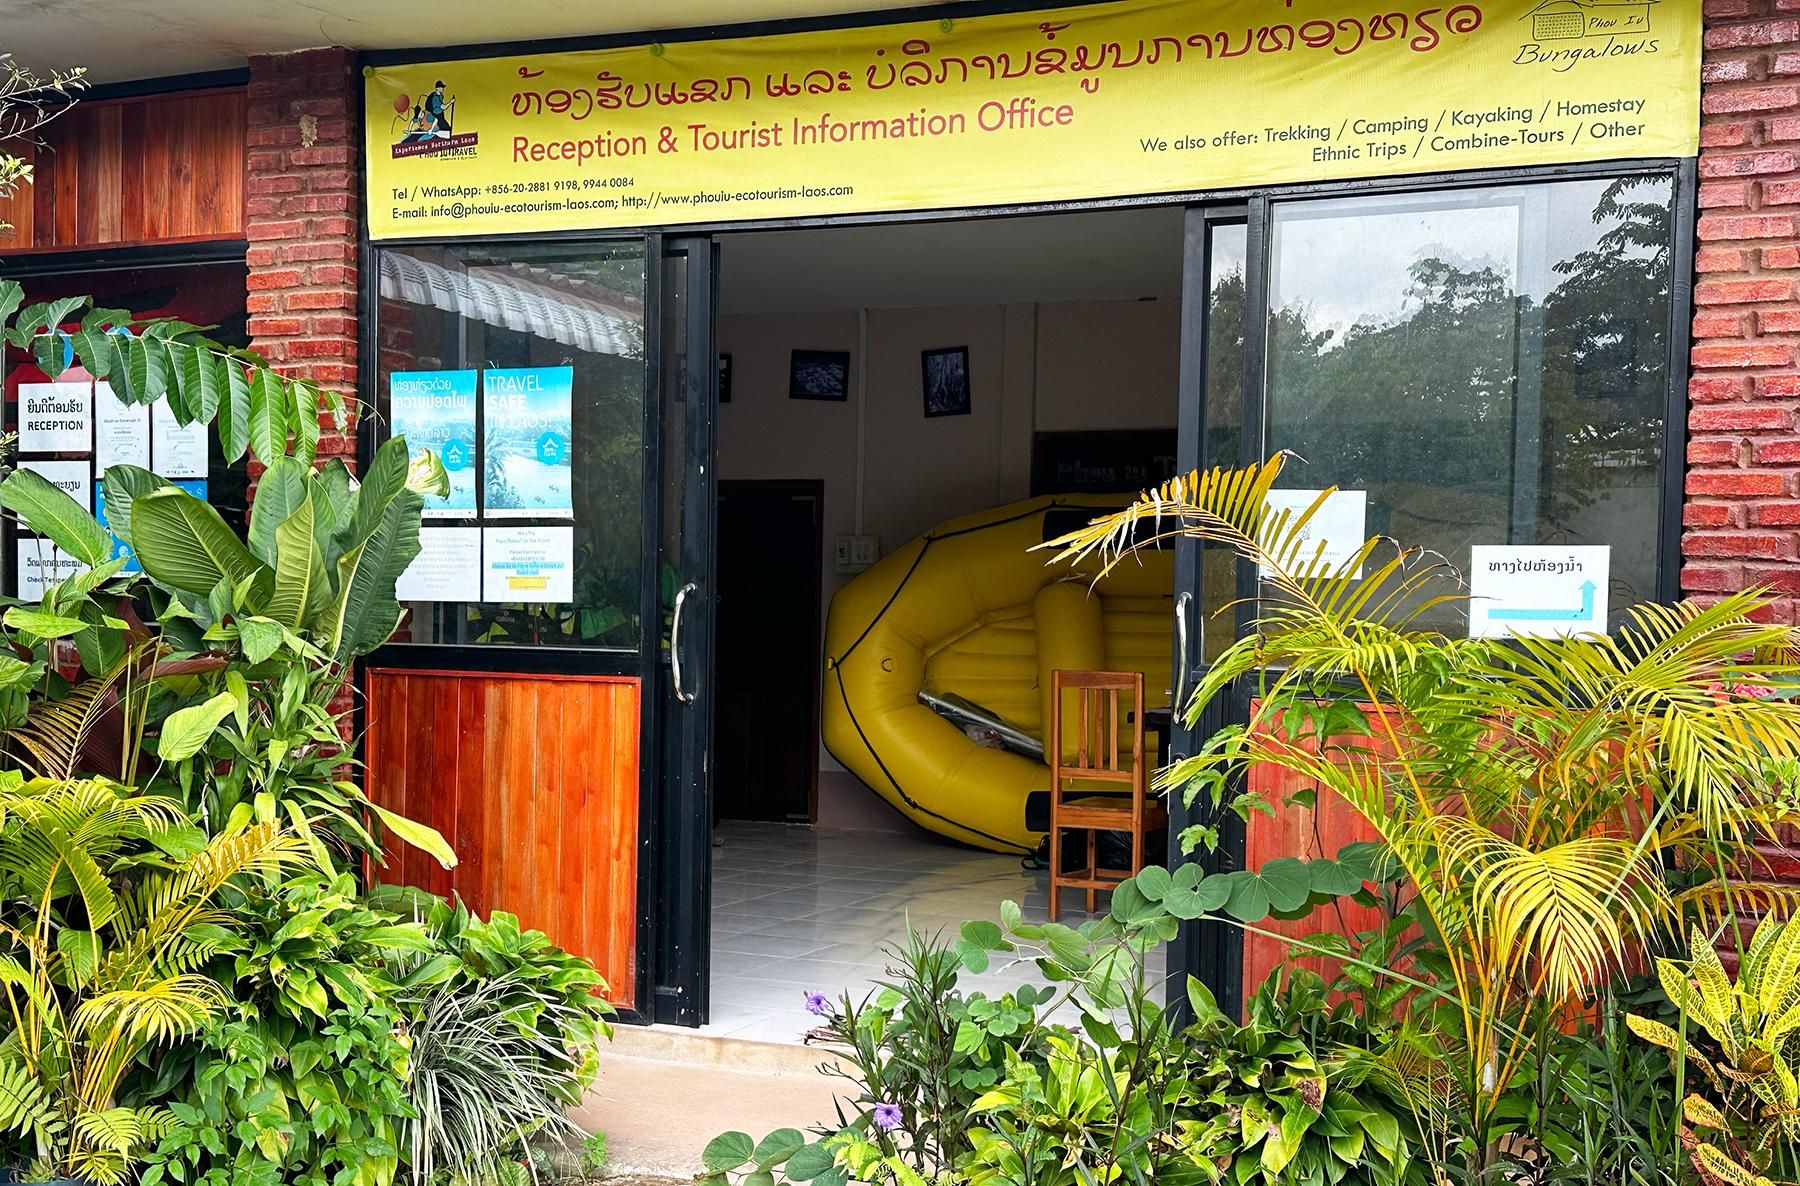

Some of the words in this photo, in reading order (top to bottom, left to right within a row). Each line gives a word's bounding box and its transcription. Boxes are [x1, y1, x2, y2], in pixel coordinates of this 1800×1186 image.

[1512, 36, 1660, 72] Bungalows
[766, 71, 852, 97] ແລະ
[513, 131, 647, 166] Reception
[657, 126, 679, 154] &
[687, 120, 783, 152] Tourist
[792, 108, 966, 145] Information
[977, 97, 1074, 132] Office
[1139, 138, 1168, 153] We
[1174, 135, 1206, 151] also
[1212, 131, 1259, 148] offer:
[1264, 125, 1331, 143] Trekking
[1336, 118, 1348, 142] /
[1352, 116, 1429, 136] Camping
[1434, 109, 1446, 133] /
[1451, 106, 1533, 128] Kayaking
[1539, 100, 1551, 123] /
[1556, 98, 1646, 117] Homestay
[1312, 145, 1360, 162] Ethnic
[1366, 141, 1407, 161] Trips
[1412, 135, 1425, 159] /
[1430, 128, 1565, 152] Combine-Tours
[1571, 122, 1583, 145] /
[1589, 121, 1646, 139] Other
[392, 188, 407, 200] Tel
[421, 184, 482, 199] WhatsApp:
[484, 181, 550, 195] +856-20-2881
[554, 179, 580, 192] 9198,
[583, 178, 607, 190] 9944
[610, 177, 634, 187] 0084
[392, 206, 427, 219] E-mail:
[431, 197, 618, 219] info@phouiu-ecotourism-laos.com;
[621, 185, 854, 209] http://www.phouiu-ecotourism-laos.com
[488, 374, 544, 392] TRAVEL
[489, 394, 526, 410] SAFE
[27, 420, 83, 431] RECEPTION
